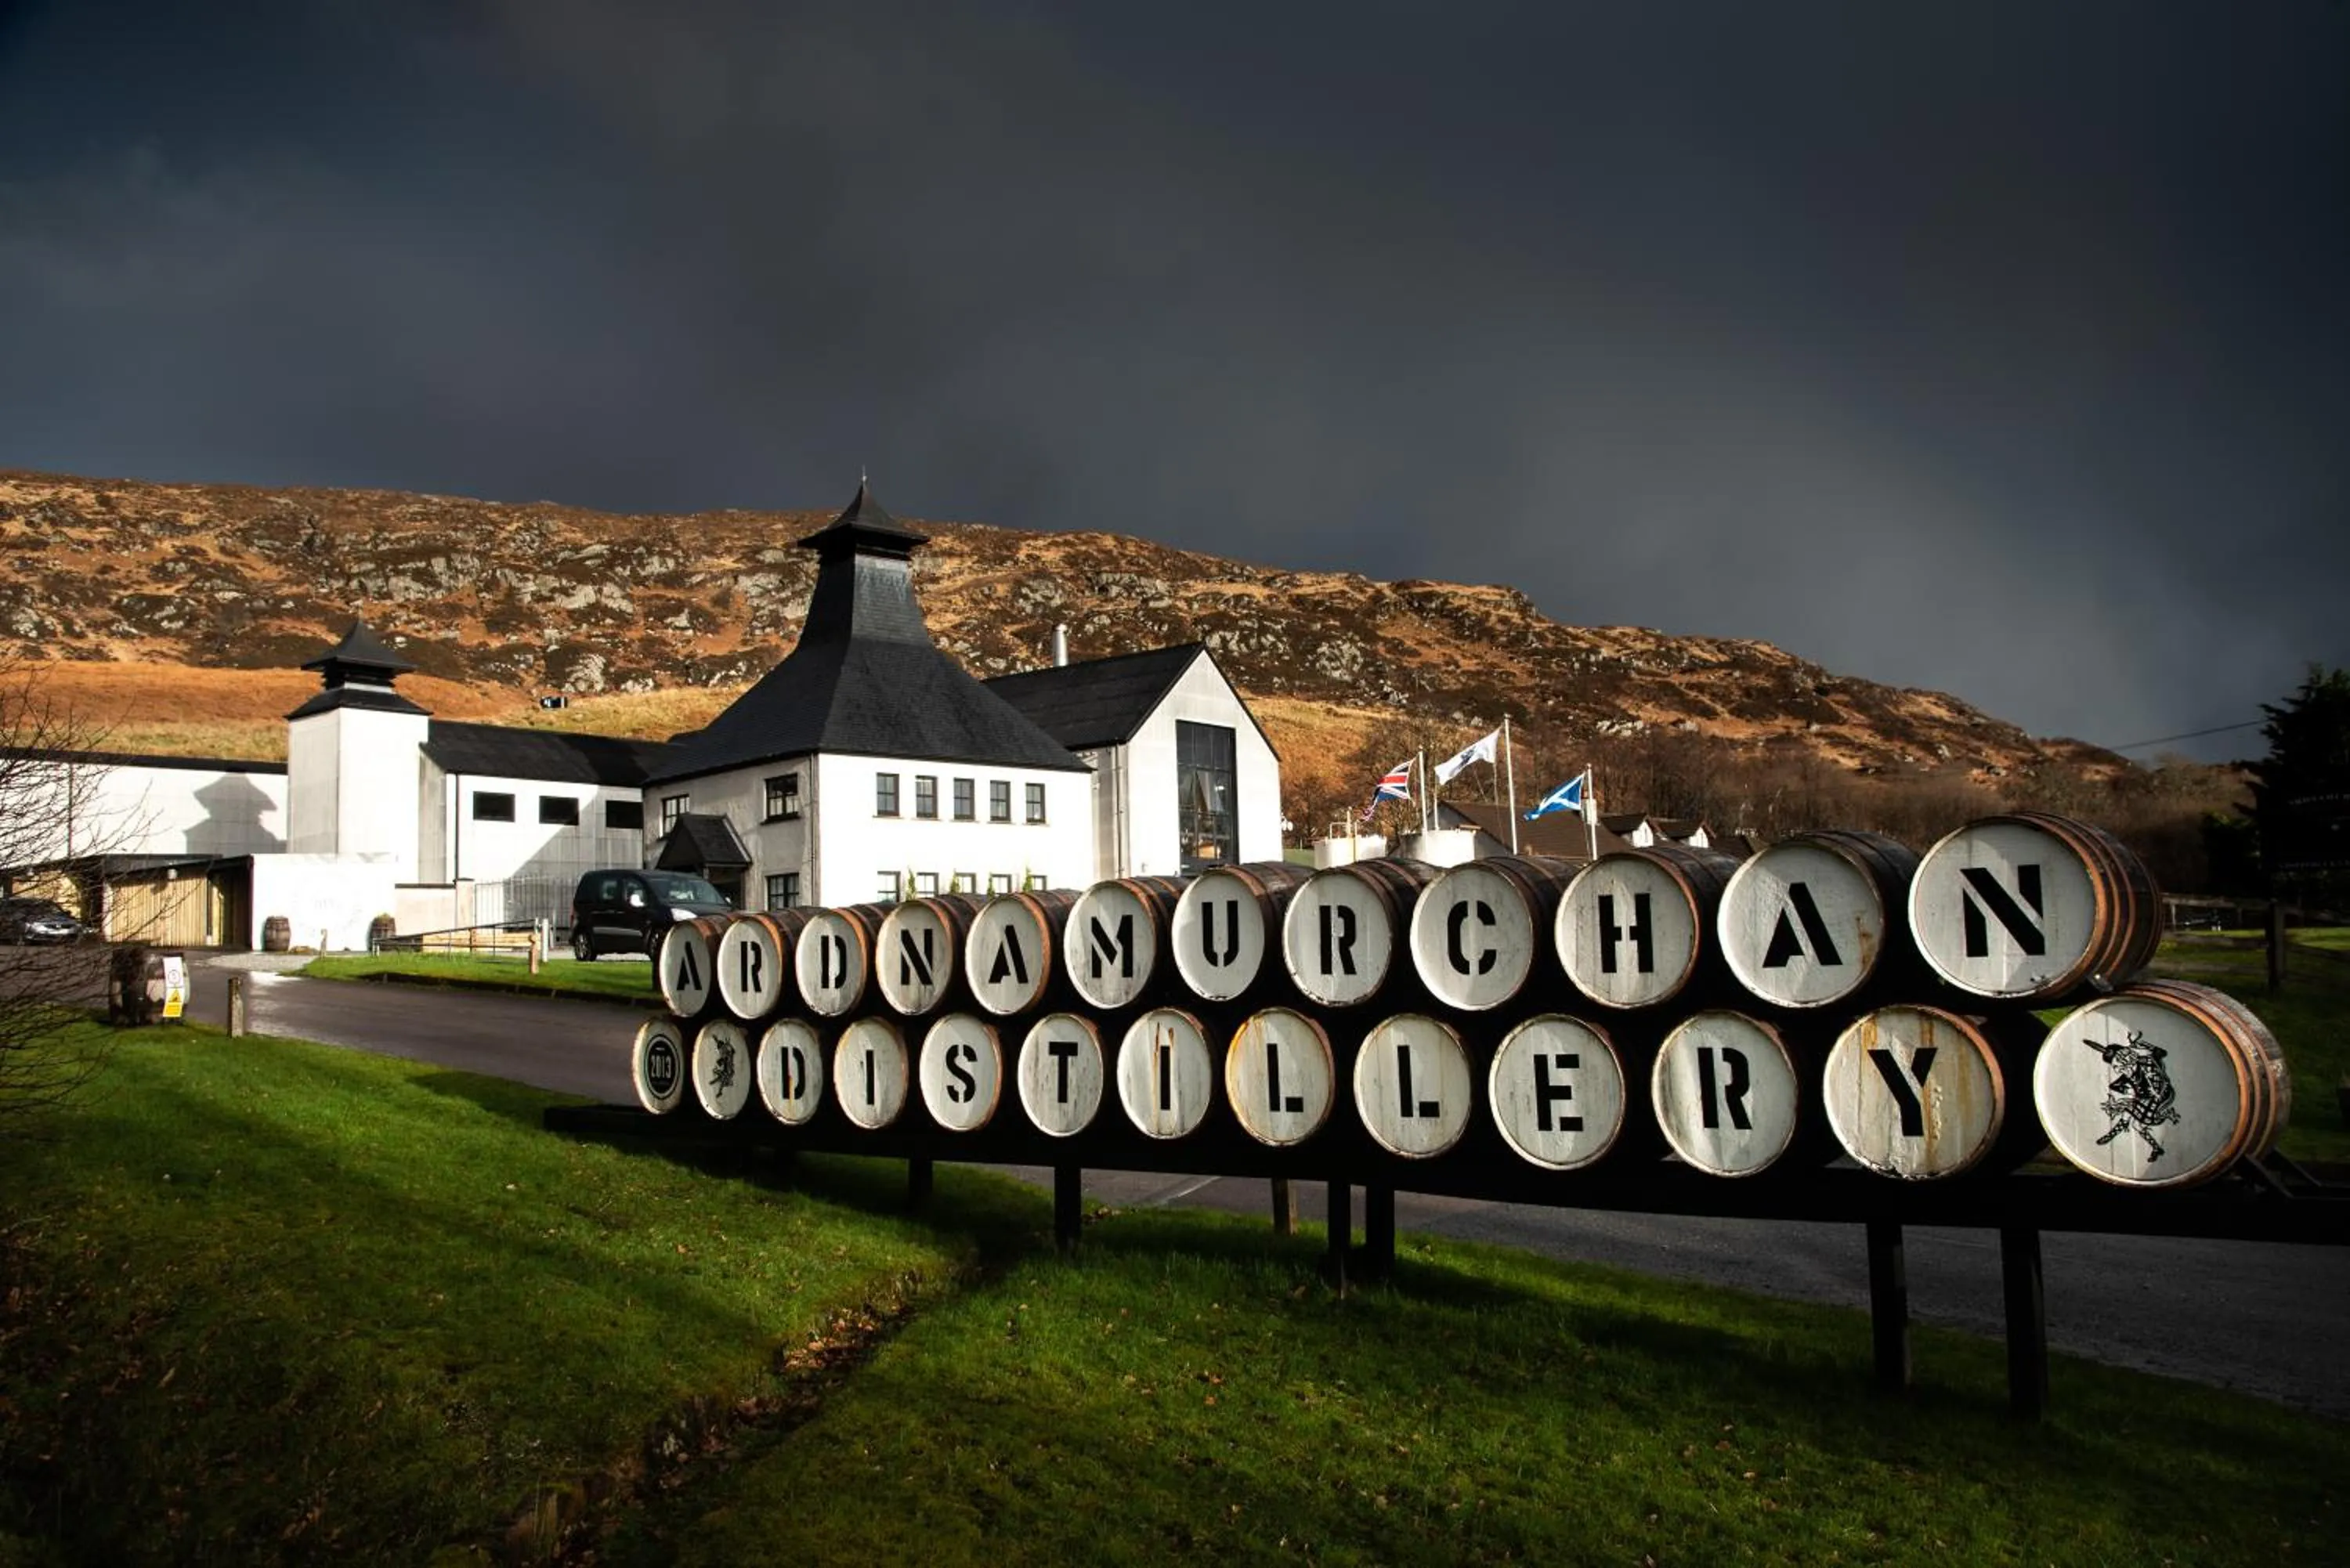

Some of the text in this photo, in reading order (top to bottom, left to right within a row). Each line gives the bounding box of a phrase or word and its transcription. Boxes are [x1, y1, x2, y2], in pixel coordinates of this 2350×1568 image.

[677, 865, 2045, 992] ARDNAMURCHAN
[651, 1055, 671, 1078] 2013
[781, 1042, 1937, 1136] DISTILLERY
